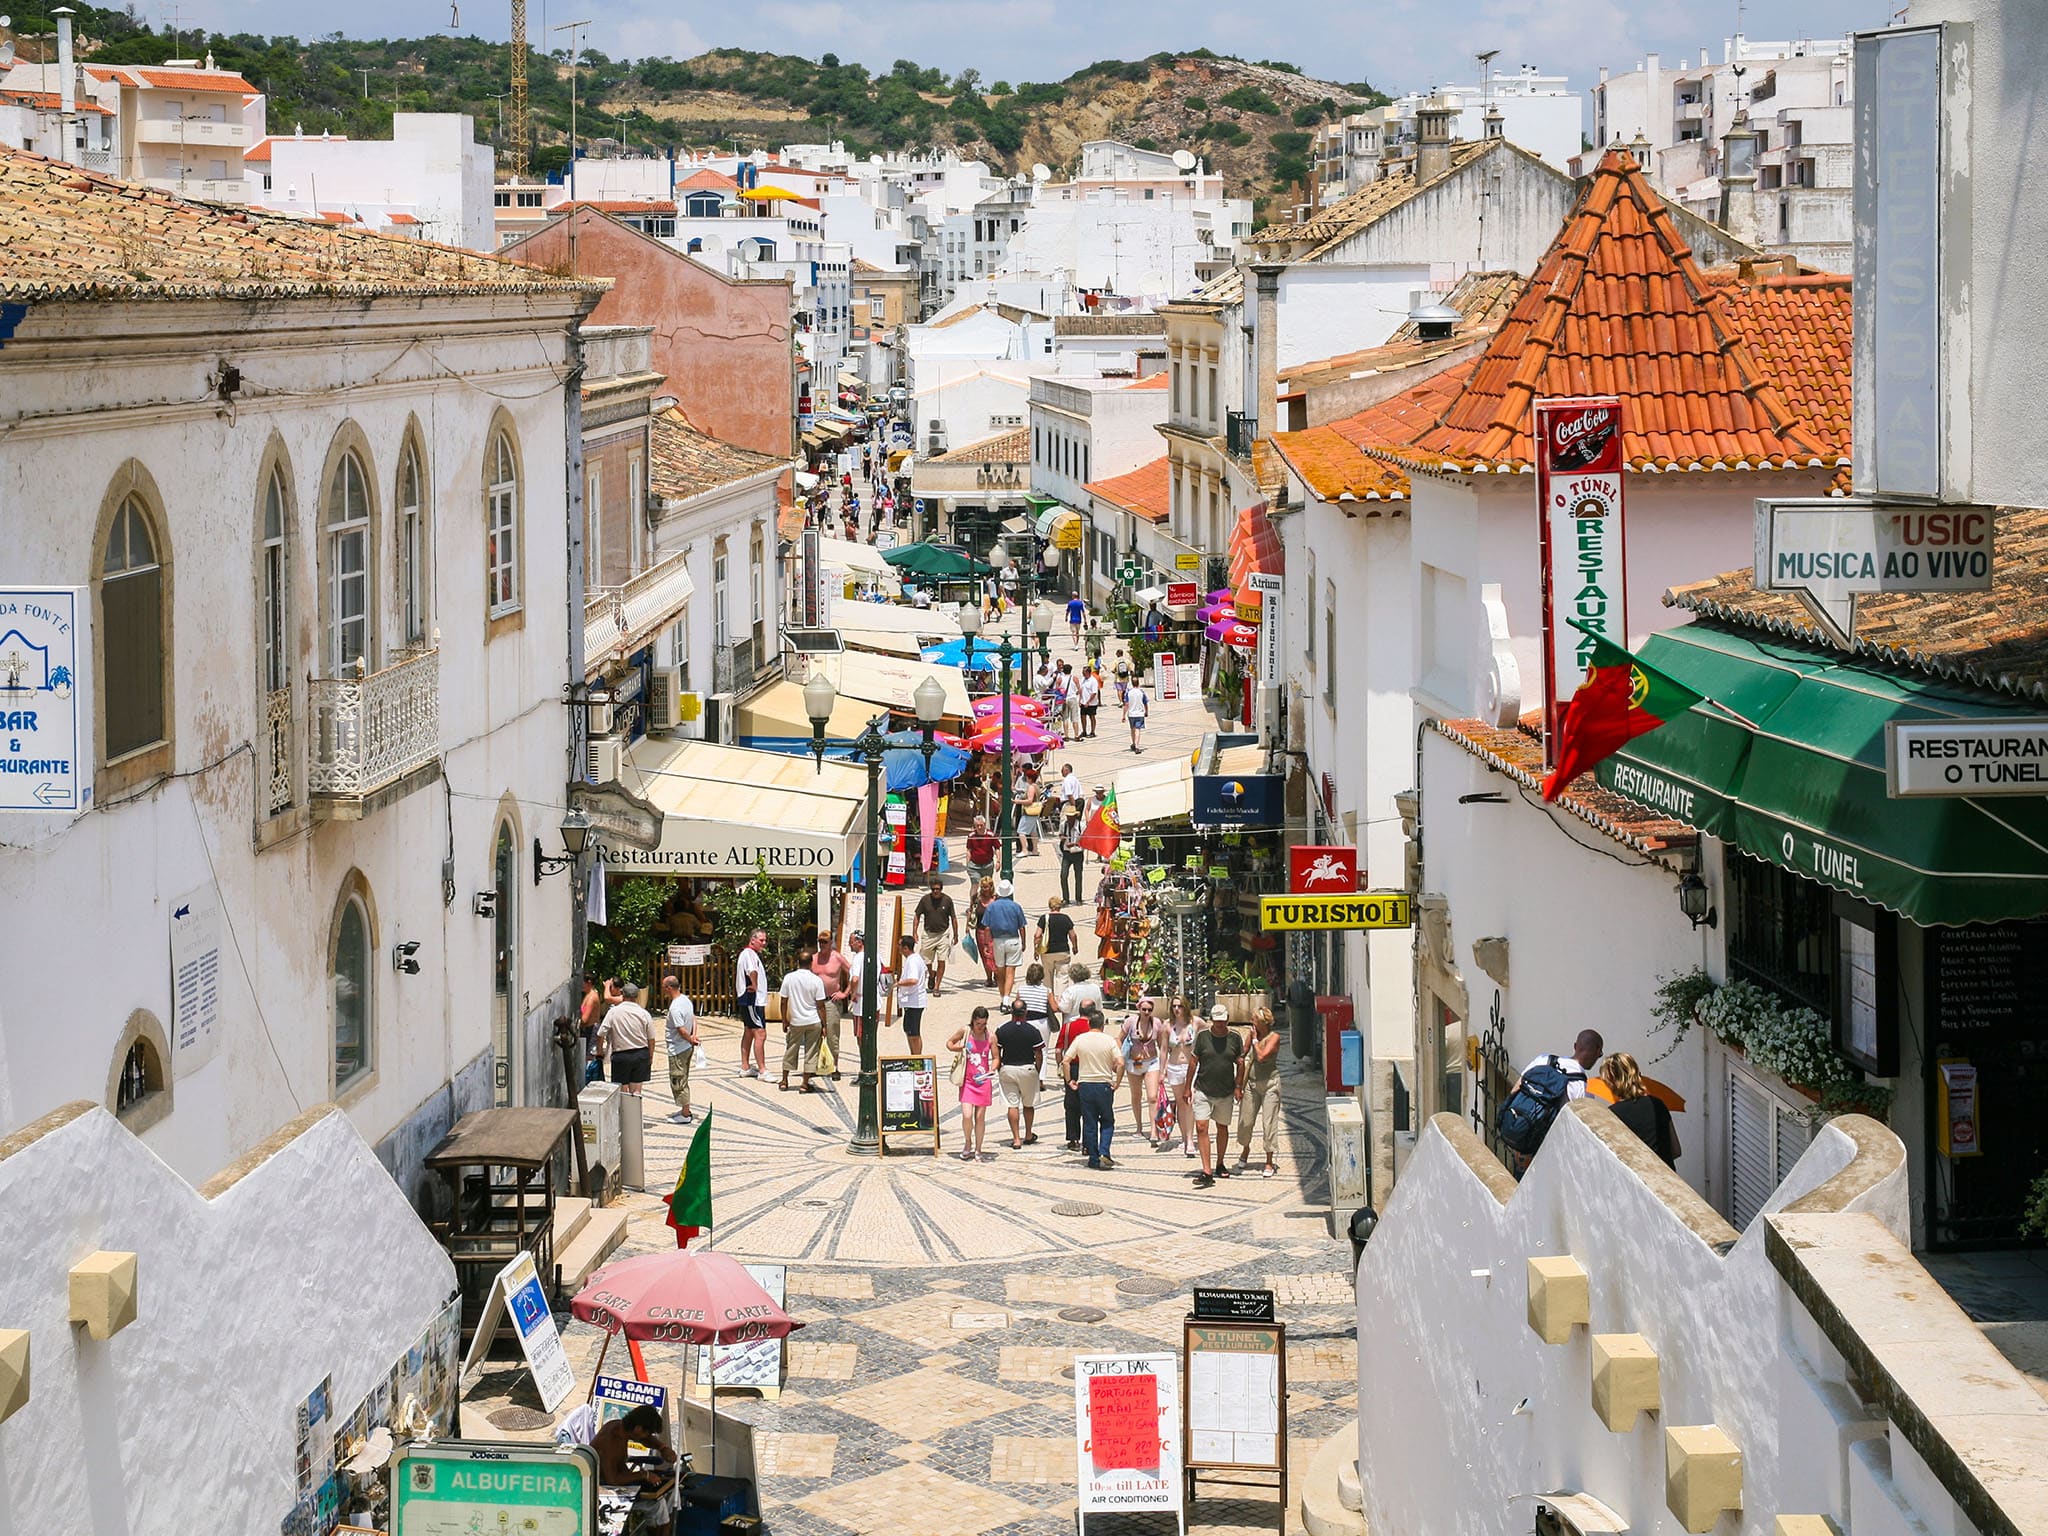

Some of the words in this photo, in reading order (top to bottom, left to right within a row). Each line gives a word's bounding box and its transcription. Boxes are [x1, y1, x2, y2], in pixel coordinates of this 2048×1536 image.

[1556, 409, 1609, 445] Coca-Cola
[1555, 494, 1567, 508] O
[1570, 476, 1618, 503] TÚNEL
[1875, 514, 1985, 546] MUSIC
[1778, 551, 1876, 579] MUSICA
[1883, 551, 1919, 579] AO
[1927, 551, 1988, 579] VIVO
[1250, 577, 1280, 589] Atrium
[1574, 519, 1608, 671] RESTAURAN
[24, 604, 70, 635] FONTE
[10, 739, 21, 752] &
[1944, 764, 1963, 784] O
[1969, 760, 2048, 783] TÚNEL
[1614, 763, 1694, 819] RESTAURANTE
[595, 845, 718, 866] Restaurante
[725, 846, 834, 867] ALFREDO
[1782, 831, 1794, 861] O
[1813, 841, 1864, 889] TUNEL
[1266, 904, 1381, 923] TURISMO
[592, 1291, 632, 1312] CARTE
[648, 1306, 705, 1321] CARTE
[724, 1305, 772, 1321] CARTE
[654, 1321, 695, 1343] D'OR
[736, 1321, 770, 1342] D'OR
[1207, 1332, 1216, 1341] O
[1218, 1333, 1261, 1342] TUNEL
[1202, 1342, 1266, 1350] RESTAURANTE
[1083, 1361, 1123, 1375] STEPS
[1128, 1361, 1153, 1374] BAR
[601, 1378, 622, 1389] BIG
[626, 1383, 661, 1396] GAME
[1094, 1389, 1146, 1399] PORTUGAL
[604, 1388, 654, 1405] FISHING
[1096, 1404, 1131, 1415] IRAN
[1097, 1437, 1130, 1446] ITALY
[469, 1450, 509, 1460] JCDecaux
[451, 1472, 572, 1493] ALBUFEIRA
[1116, 1480, 1133, 1490] till
[1136, 1479, 1169, 1490] LATE
[1109, 1495, 1169, 1504] CONDITIONED
